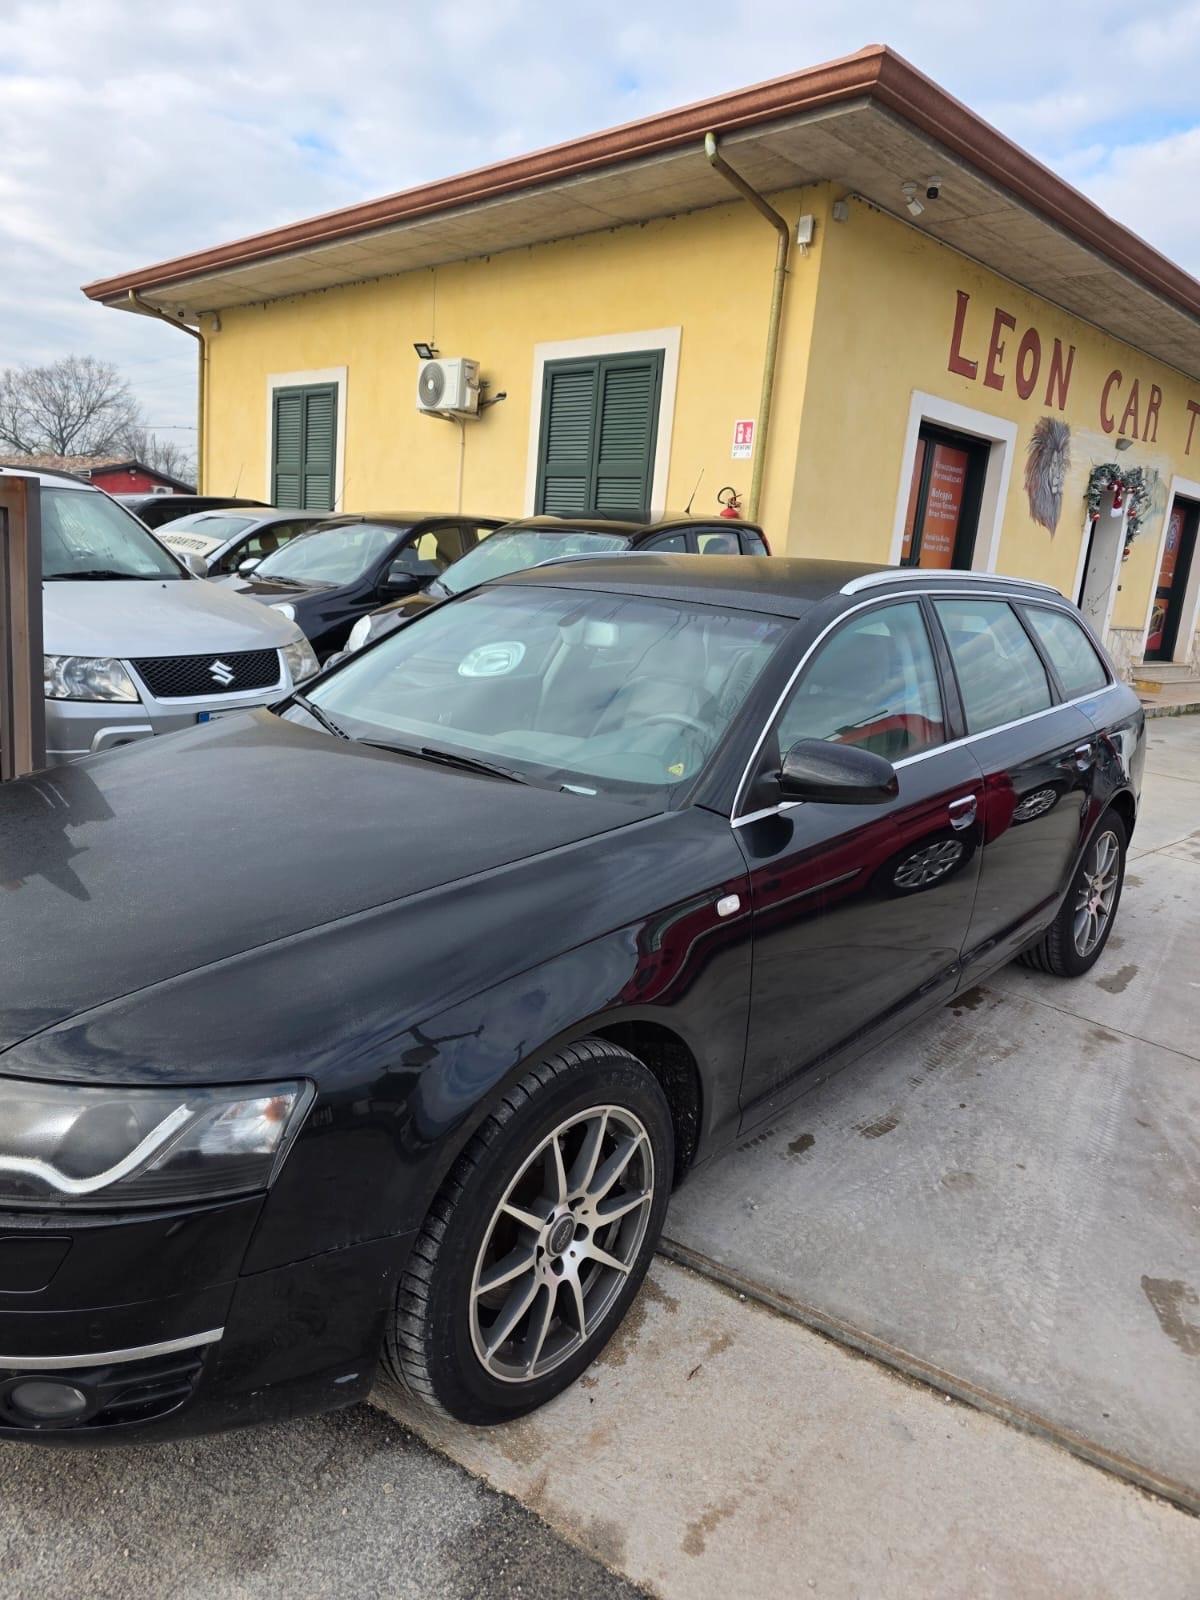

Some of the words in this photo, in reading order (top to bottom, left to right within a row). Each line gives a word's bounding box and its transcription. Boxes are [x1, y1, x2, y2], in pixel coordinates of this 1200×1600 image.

[948, 289, 1076, 411] LEON
[1100, 369, 1163, 443] CAR
[931, 488, 952, 500] Noleggio
